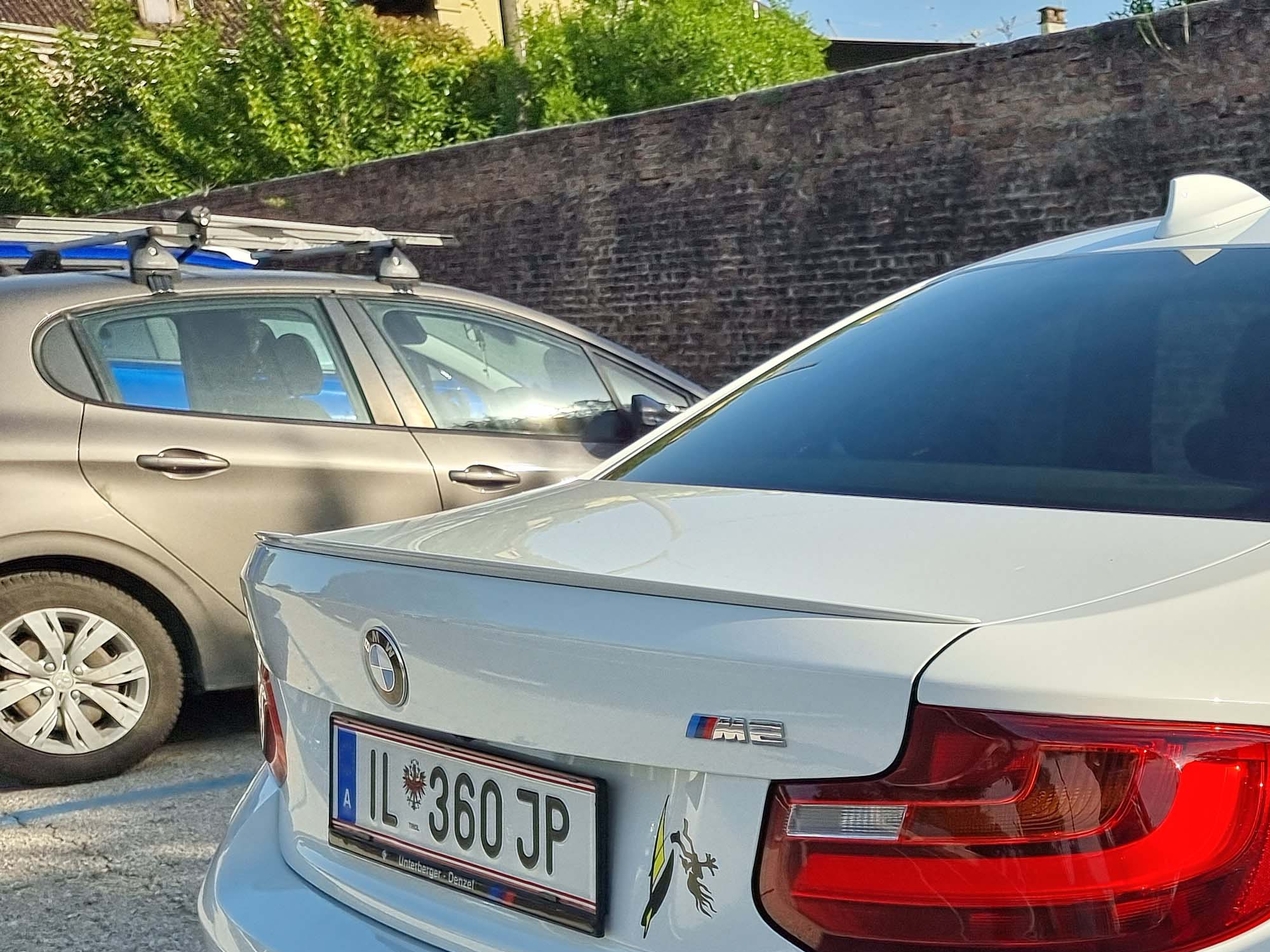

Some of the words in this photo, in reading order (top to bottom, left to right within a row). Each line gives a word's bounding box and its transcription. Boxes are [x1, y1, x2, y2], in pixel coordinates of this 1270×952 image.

[364, 630, 395, 658] BMW
[712, 716, 787, 747] M2
[343, 788, 351, 809] A
[370, 749, 398, 827] IL
[428, 766, 502, 858] 360
[516, 788, 570, 876] JP
[398, 854, 442, 879] Unterberger
[448, 871, 475, 890] Denzel
